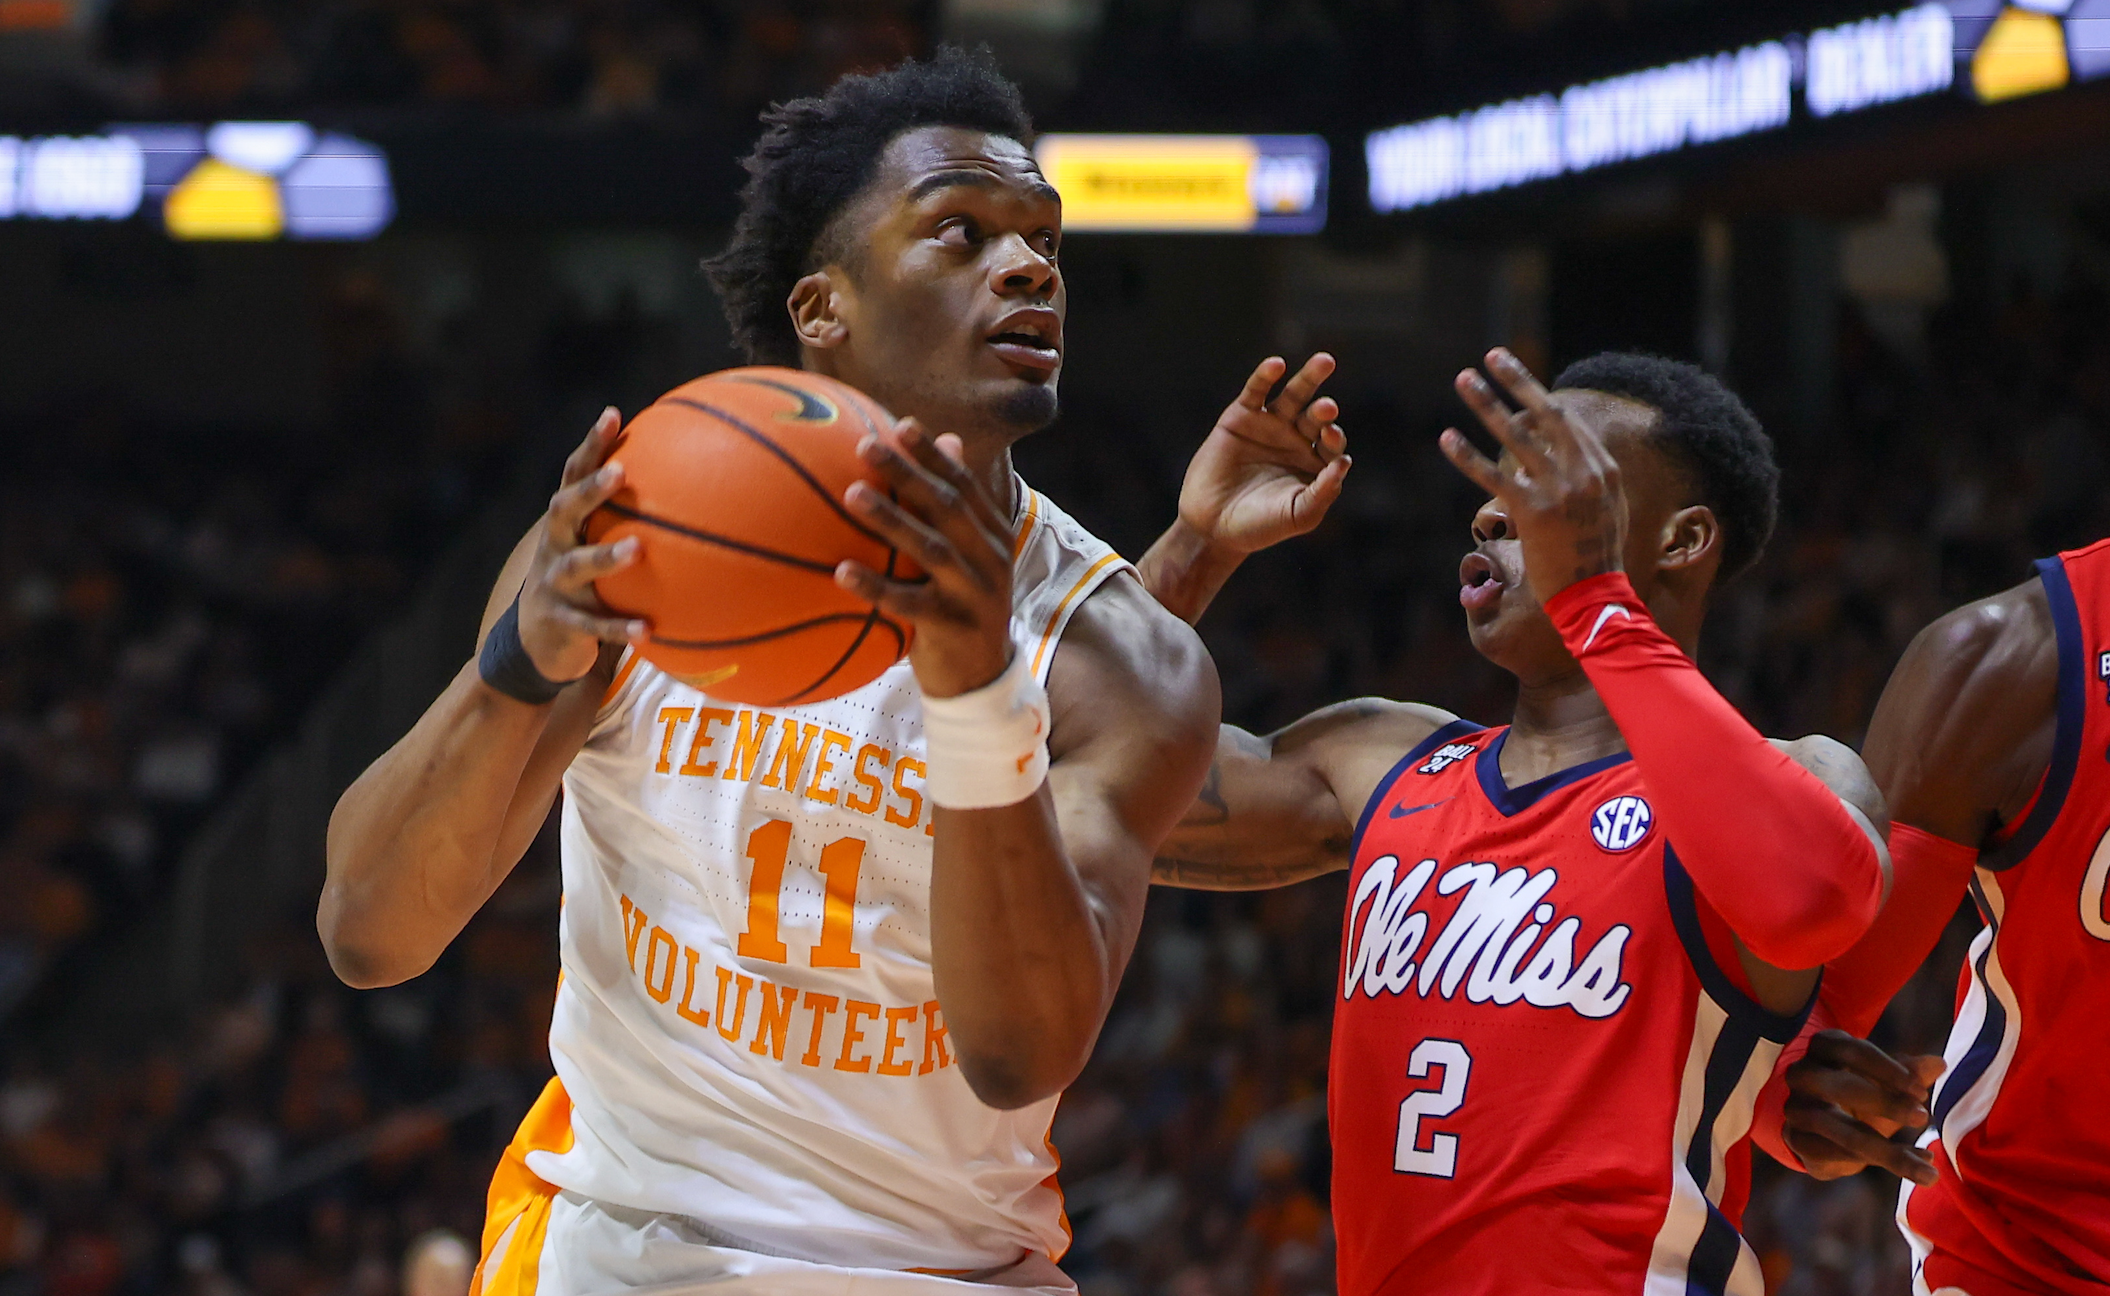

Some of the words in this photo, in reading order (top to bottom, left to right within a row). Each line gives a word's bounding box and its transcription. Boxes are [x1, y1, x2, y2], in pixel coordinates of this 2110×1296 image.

[655, 706, 935, 837] TENNESS
[1591, 796, 1652, 850] SEC
[736, 818, 867, 969] 11
[1344, 854, 1438, 1001] Ole
[1418, 861, 1633, 1020] Miss
[620, 893, 959, 1077] VOLUNTEER
[1393, 1036, 1473, 1179] 2
